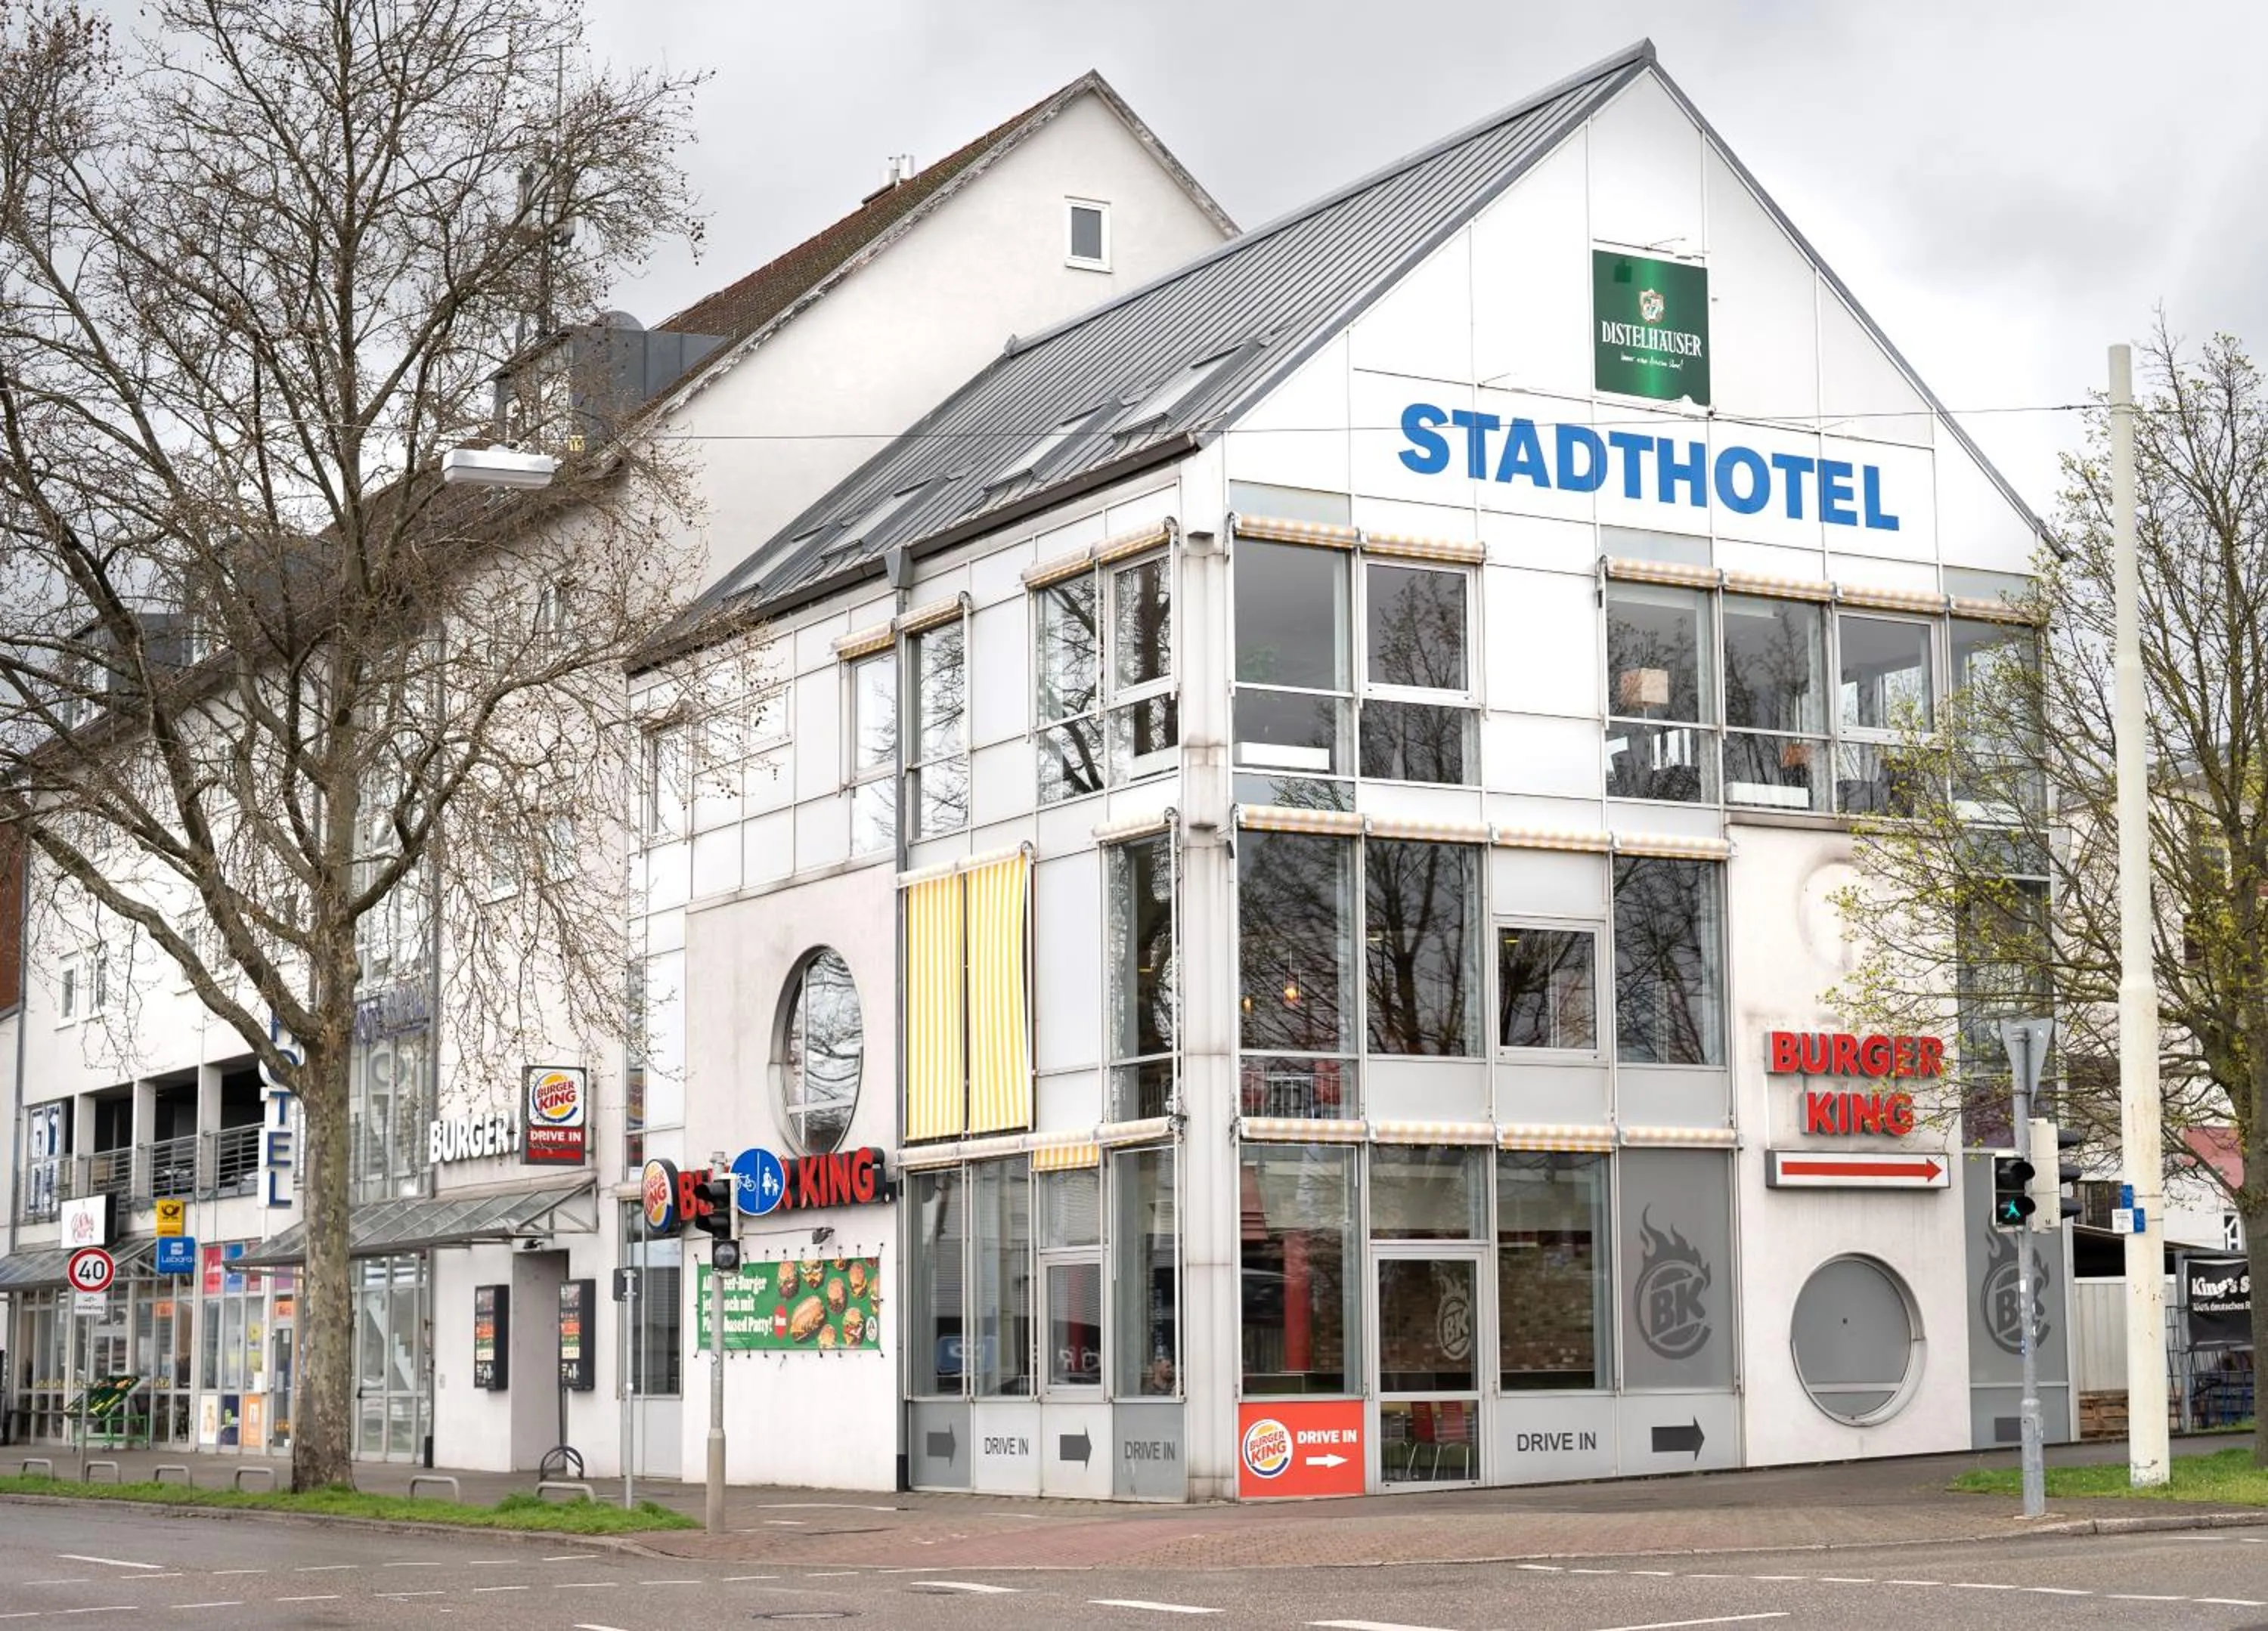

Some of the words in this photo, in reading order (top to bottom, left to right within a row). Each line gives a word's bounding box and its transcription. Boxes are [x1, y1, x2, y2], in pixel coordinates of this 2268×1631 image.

[1398, 402, 1899, 531] STADTHOTEL
[1771, 1030, 1944, 1077] BURGER
[538, 1081, 575, 1098] BURGER
[539, 1091, 577, 1111] KING
[1805, 1091, 1914, 1136] KING
[429, 1110, 510, 1162] BURGER
[530, 1130, 565, 1142] DRIVE
[569, 1129, 581, 1141] IN
[798, 1147, 875, 1209] KING
[78, 1261, 105, 1280] 40
[1650, 1282, 1707, 1335] BK
[748, 1315, 773, 1336] Patty!
[1445, 1311, 1468, 1342] BK
[985, 1438, 1016, 1455] DRIVE
[1018, 1438, 1029, 1456] IN
[1250, 1431, 1284, 1451] BURGER
[1297, 1430, 1340, 1444] DRIVE
[1342, 1429, 1358, 1443] IN
[1517, 1432, 1573, 1452] DRIVE
[1579, 1431, 1596, 1450] IN
[1124, 1441, 1160, 1460] DRIVE
[1163, 1441, 1176, 1460] IN
[1251, 1441, 1287, 1465] KING
